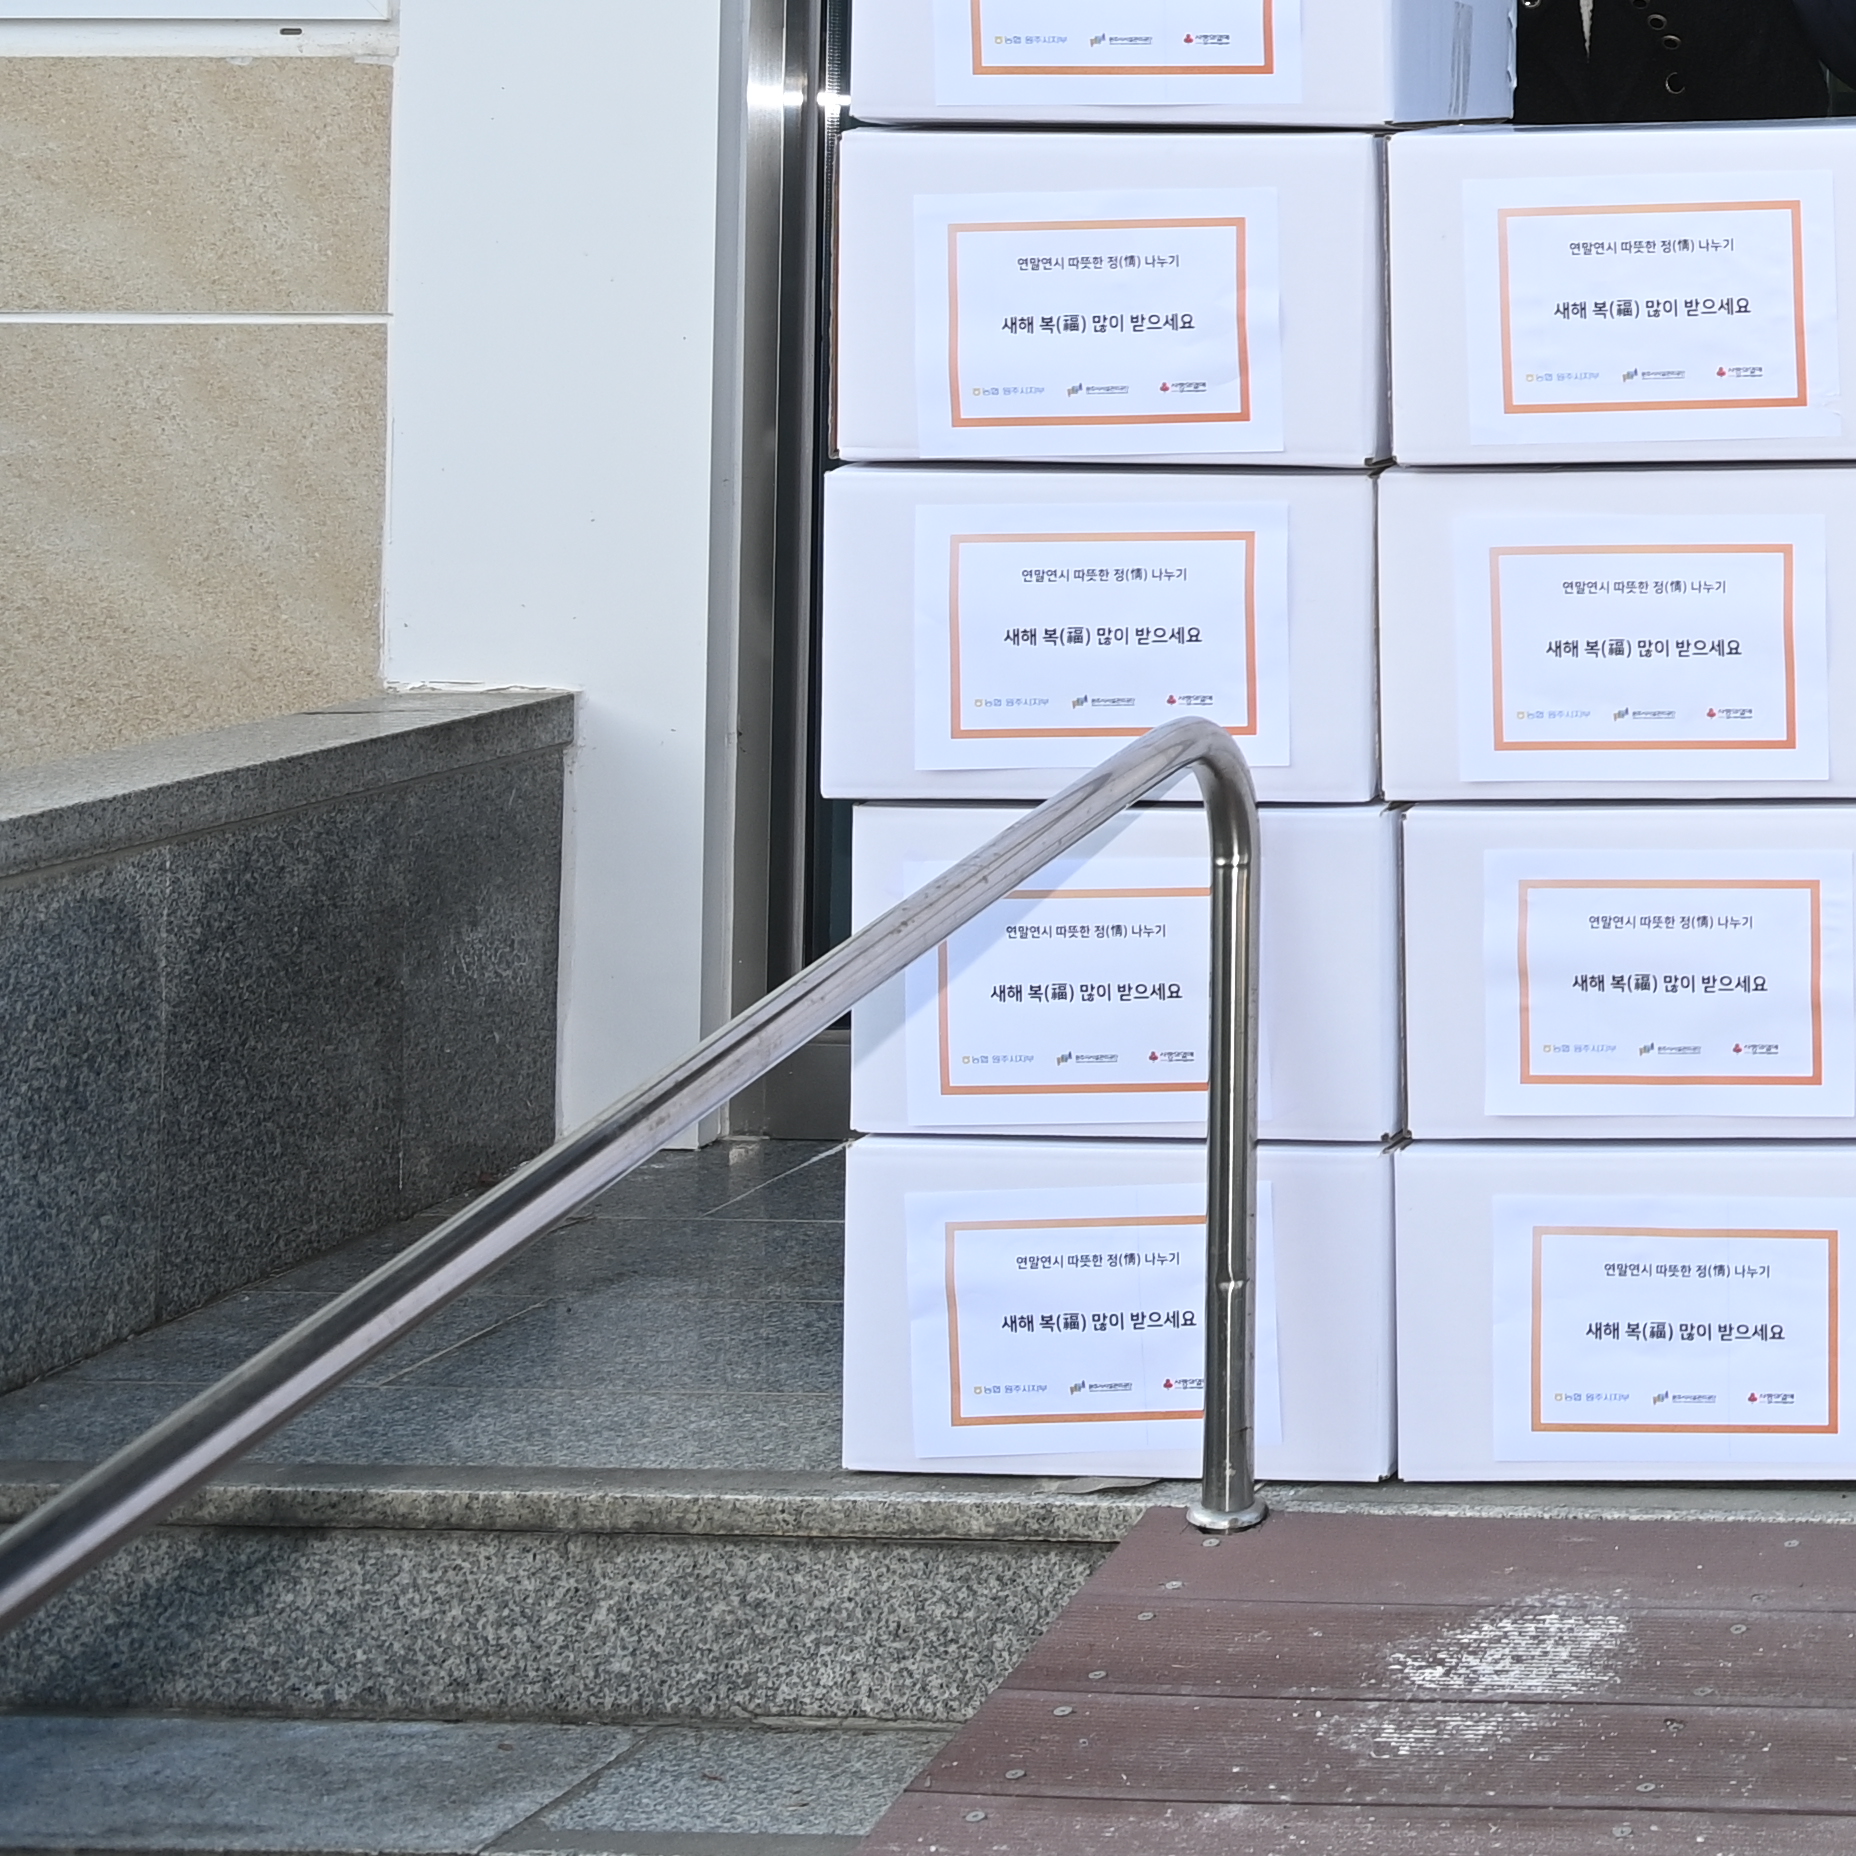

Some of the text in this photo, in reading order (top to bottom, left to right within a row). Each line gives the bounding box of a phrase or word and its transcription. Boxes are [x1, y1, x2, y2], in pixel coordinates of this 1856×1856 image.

[1001, 315, 1035, 335] 새해
[1091, 313, 1124, 334] 많이
[1129, 312, 1196, 333] 받으세요
[1003, 627, 1037, 647] 새해
[1096, 626, 1129, 646] 많이
[1135, 626, 1203, 646] 받으세요
[990, 983, 1023, 1003] 새해
[1079, 982, 1112, 1003] 많이
[1117, 982, 1183, 1002] 받으세요
[1001, 1313, 1035, 1334] 새해
[1091, 1311, 1125, 1332] 많이
[1130, 1309, 1198, 1331] 받으세요
